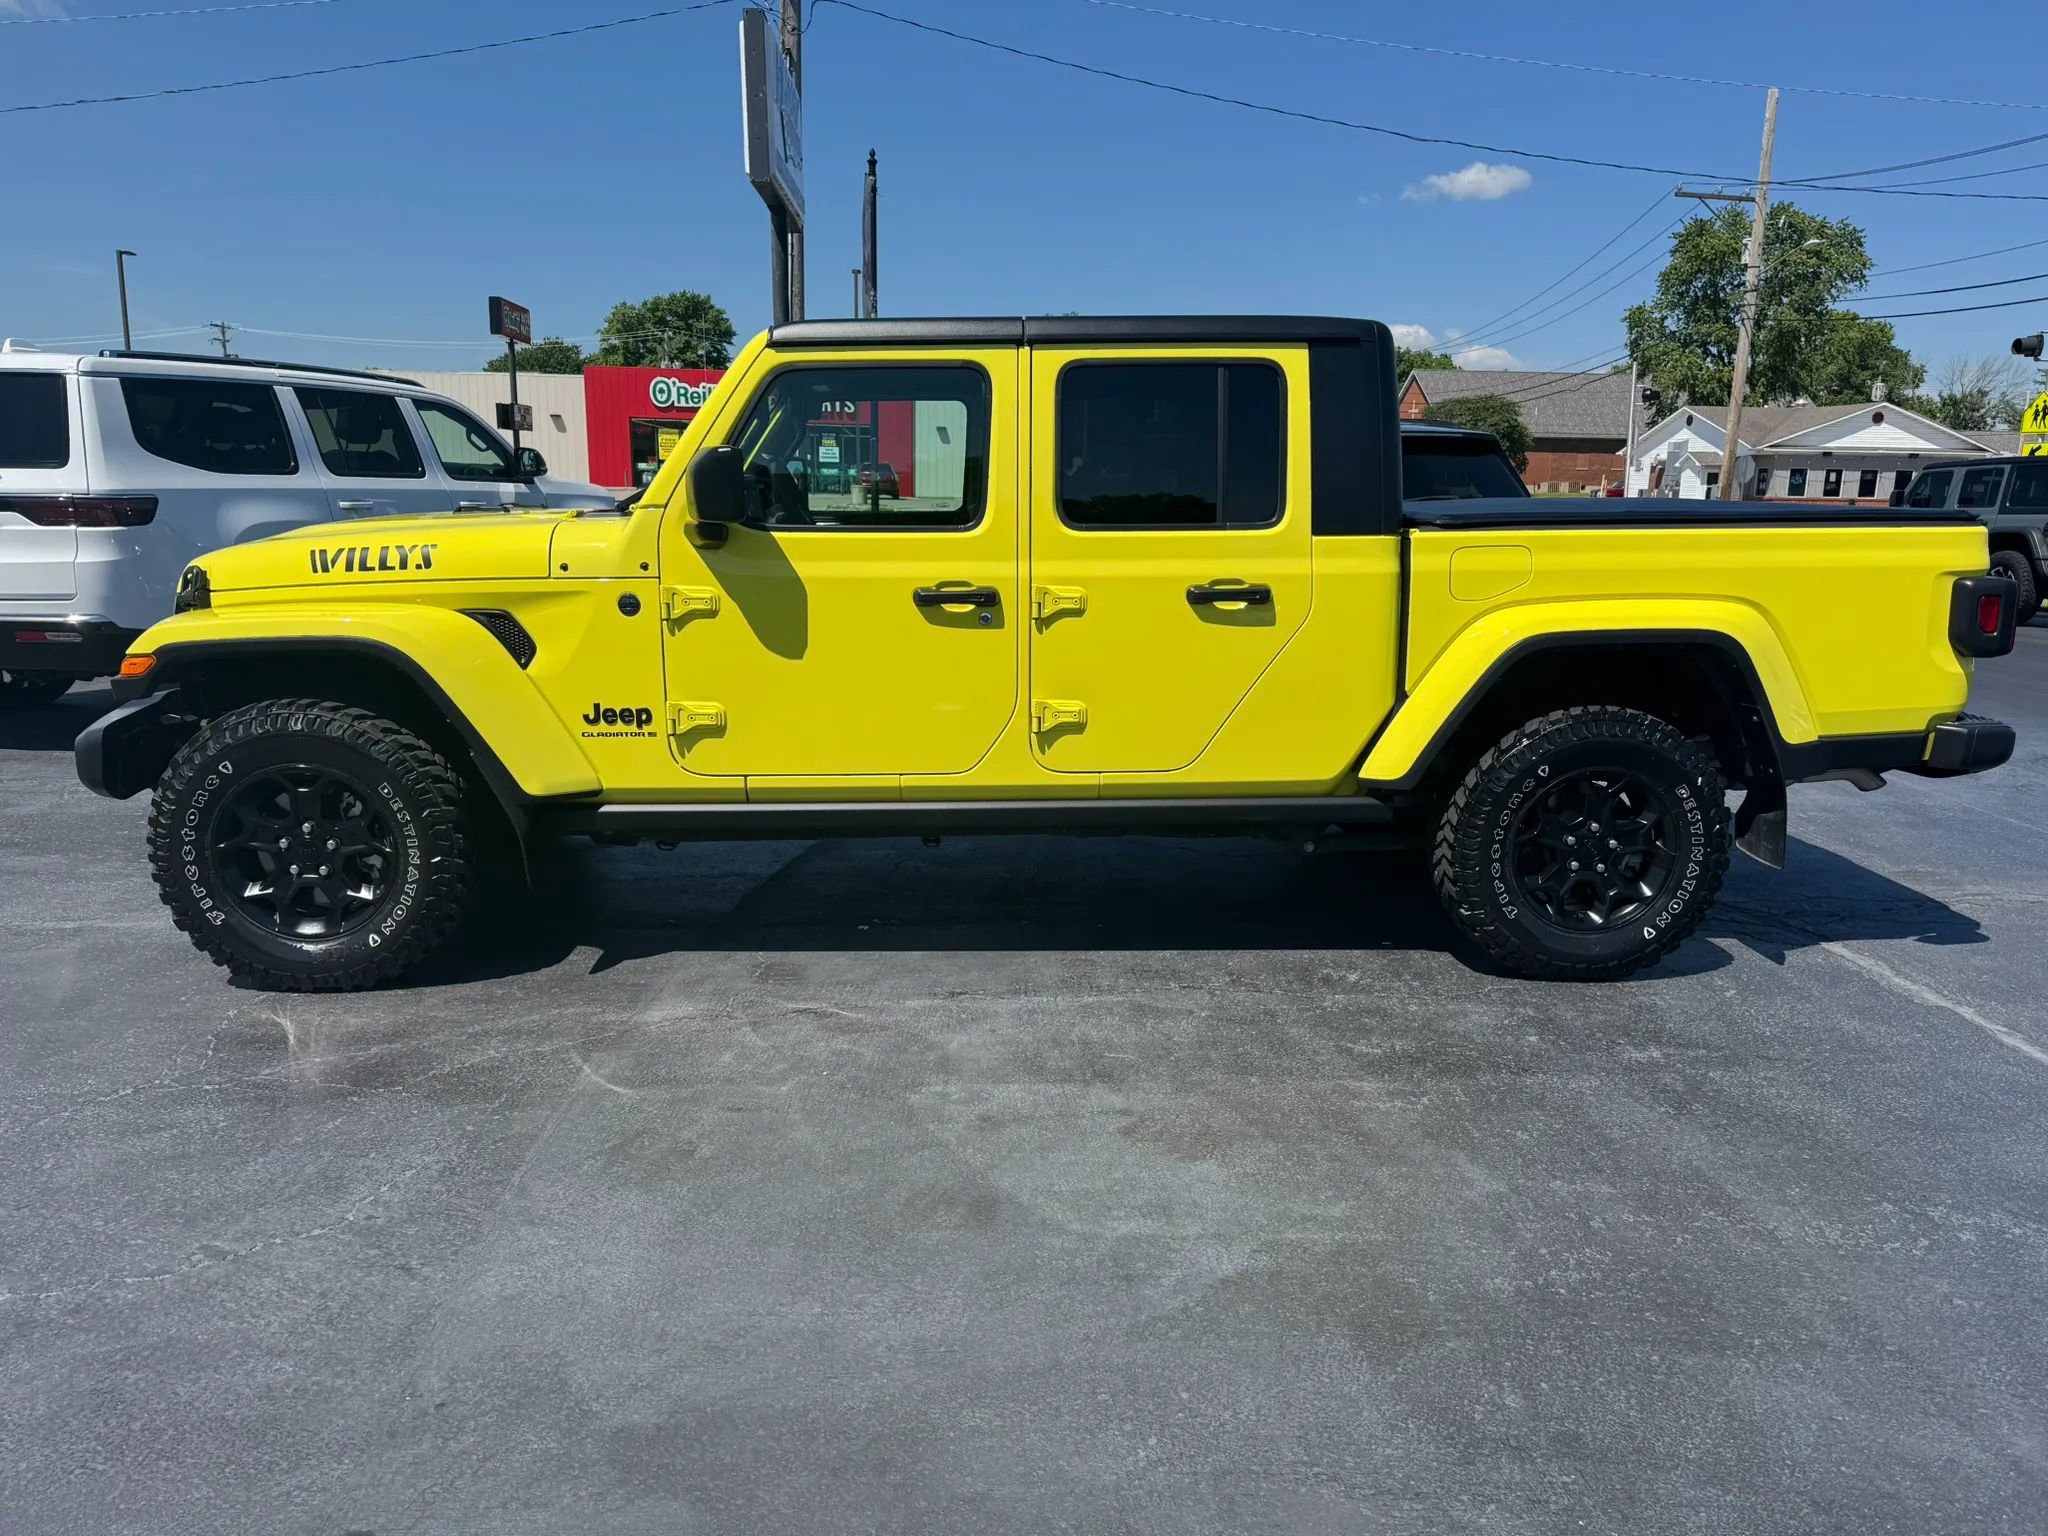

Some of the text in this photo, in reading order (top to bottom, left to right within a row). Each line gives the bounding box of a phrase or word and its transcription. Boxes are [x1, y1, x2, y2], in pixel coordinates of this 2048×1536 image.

[310, 544, 437, 573] WILLYS
[582, 702, 653, 730] Jeep
[181, 774, 226, 926] Firestone
[377, 782, 422, 937] DESTINATION
[1656, 783, 1706, 929] DESTINATION
